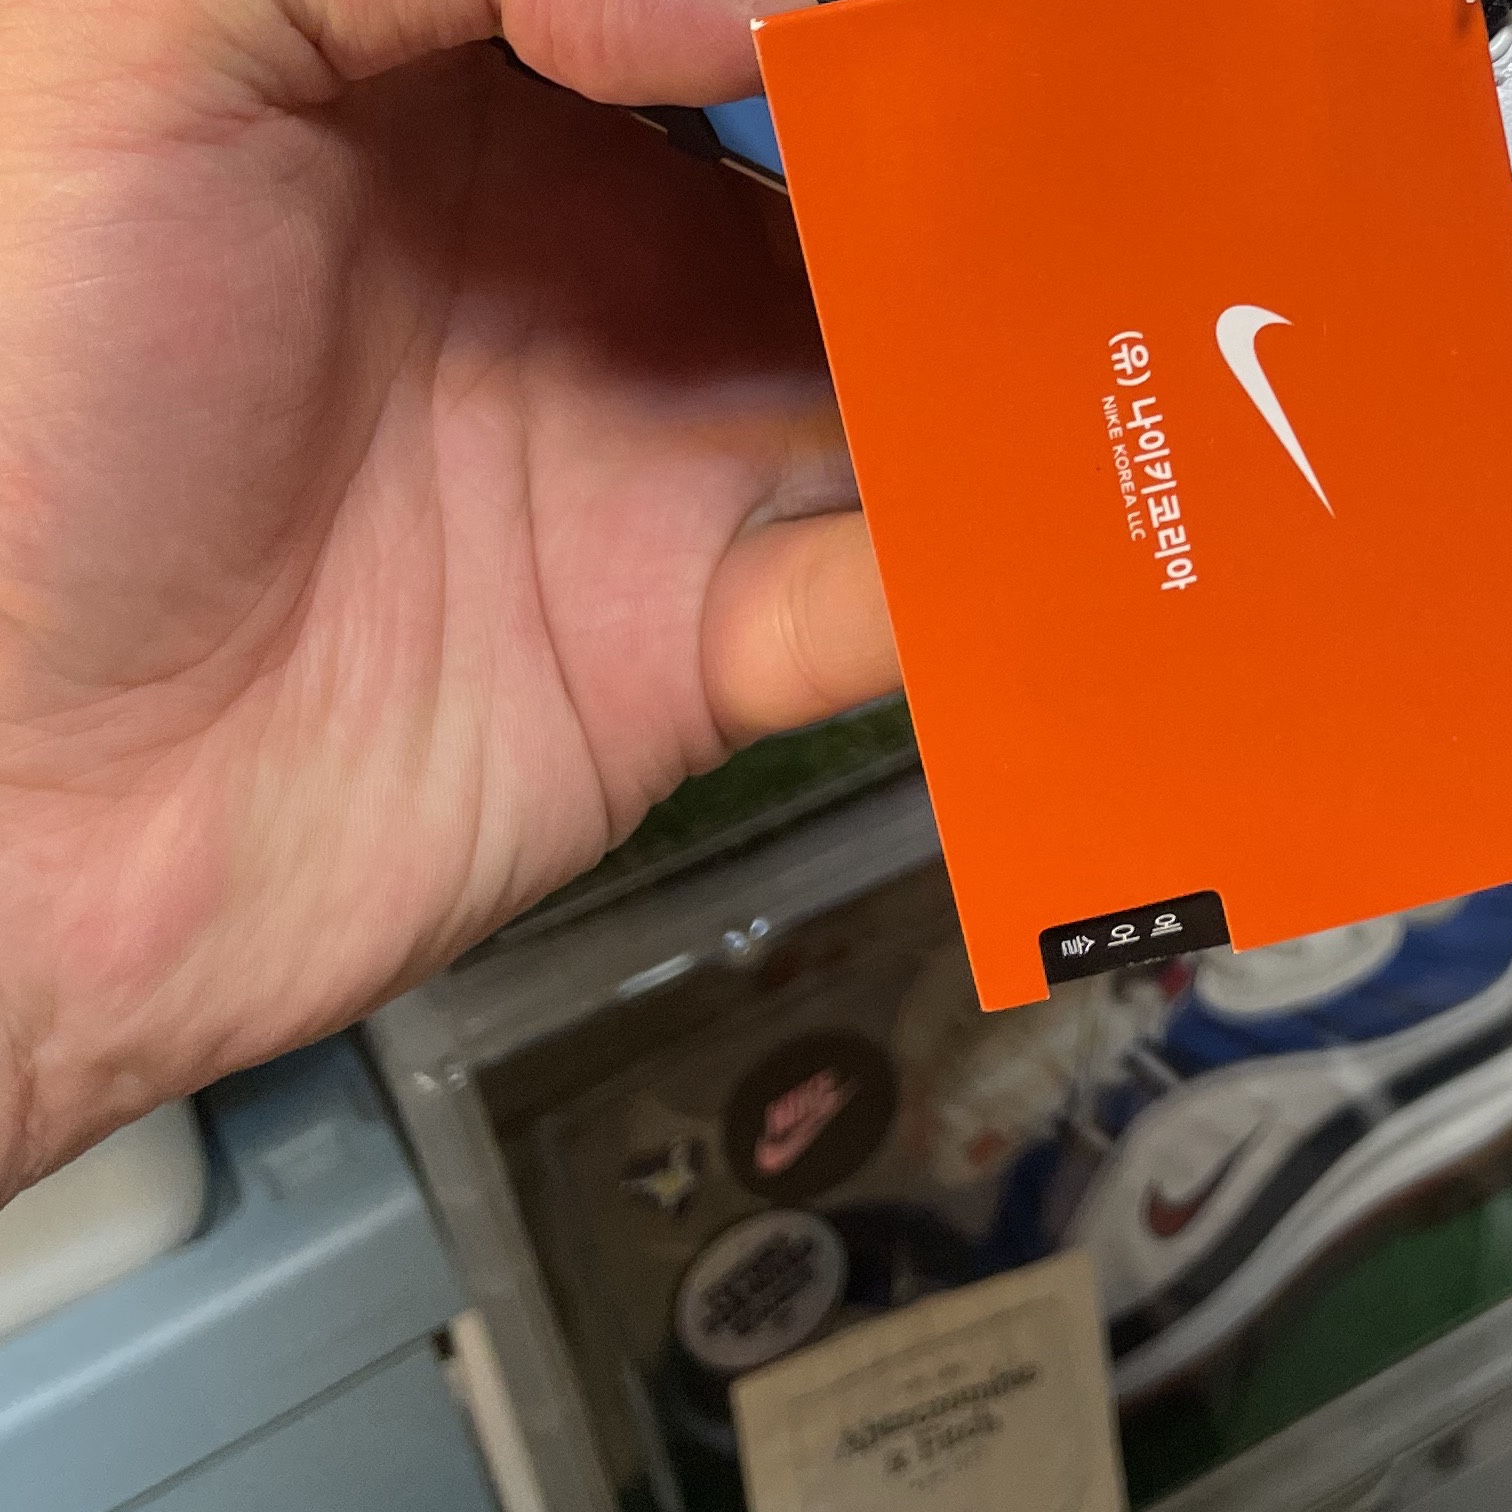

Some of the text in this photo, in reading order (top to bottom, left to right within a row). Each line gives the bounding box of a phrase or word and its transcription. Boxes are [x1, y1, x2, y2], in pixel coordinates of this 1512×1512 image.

[1101, 395, 1147, 542] NIKE KOREA LLC
[1108, 330, 1198, 591] (유) 나이키코리아
